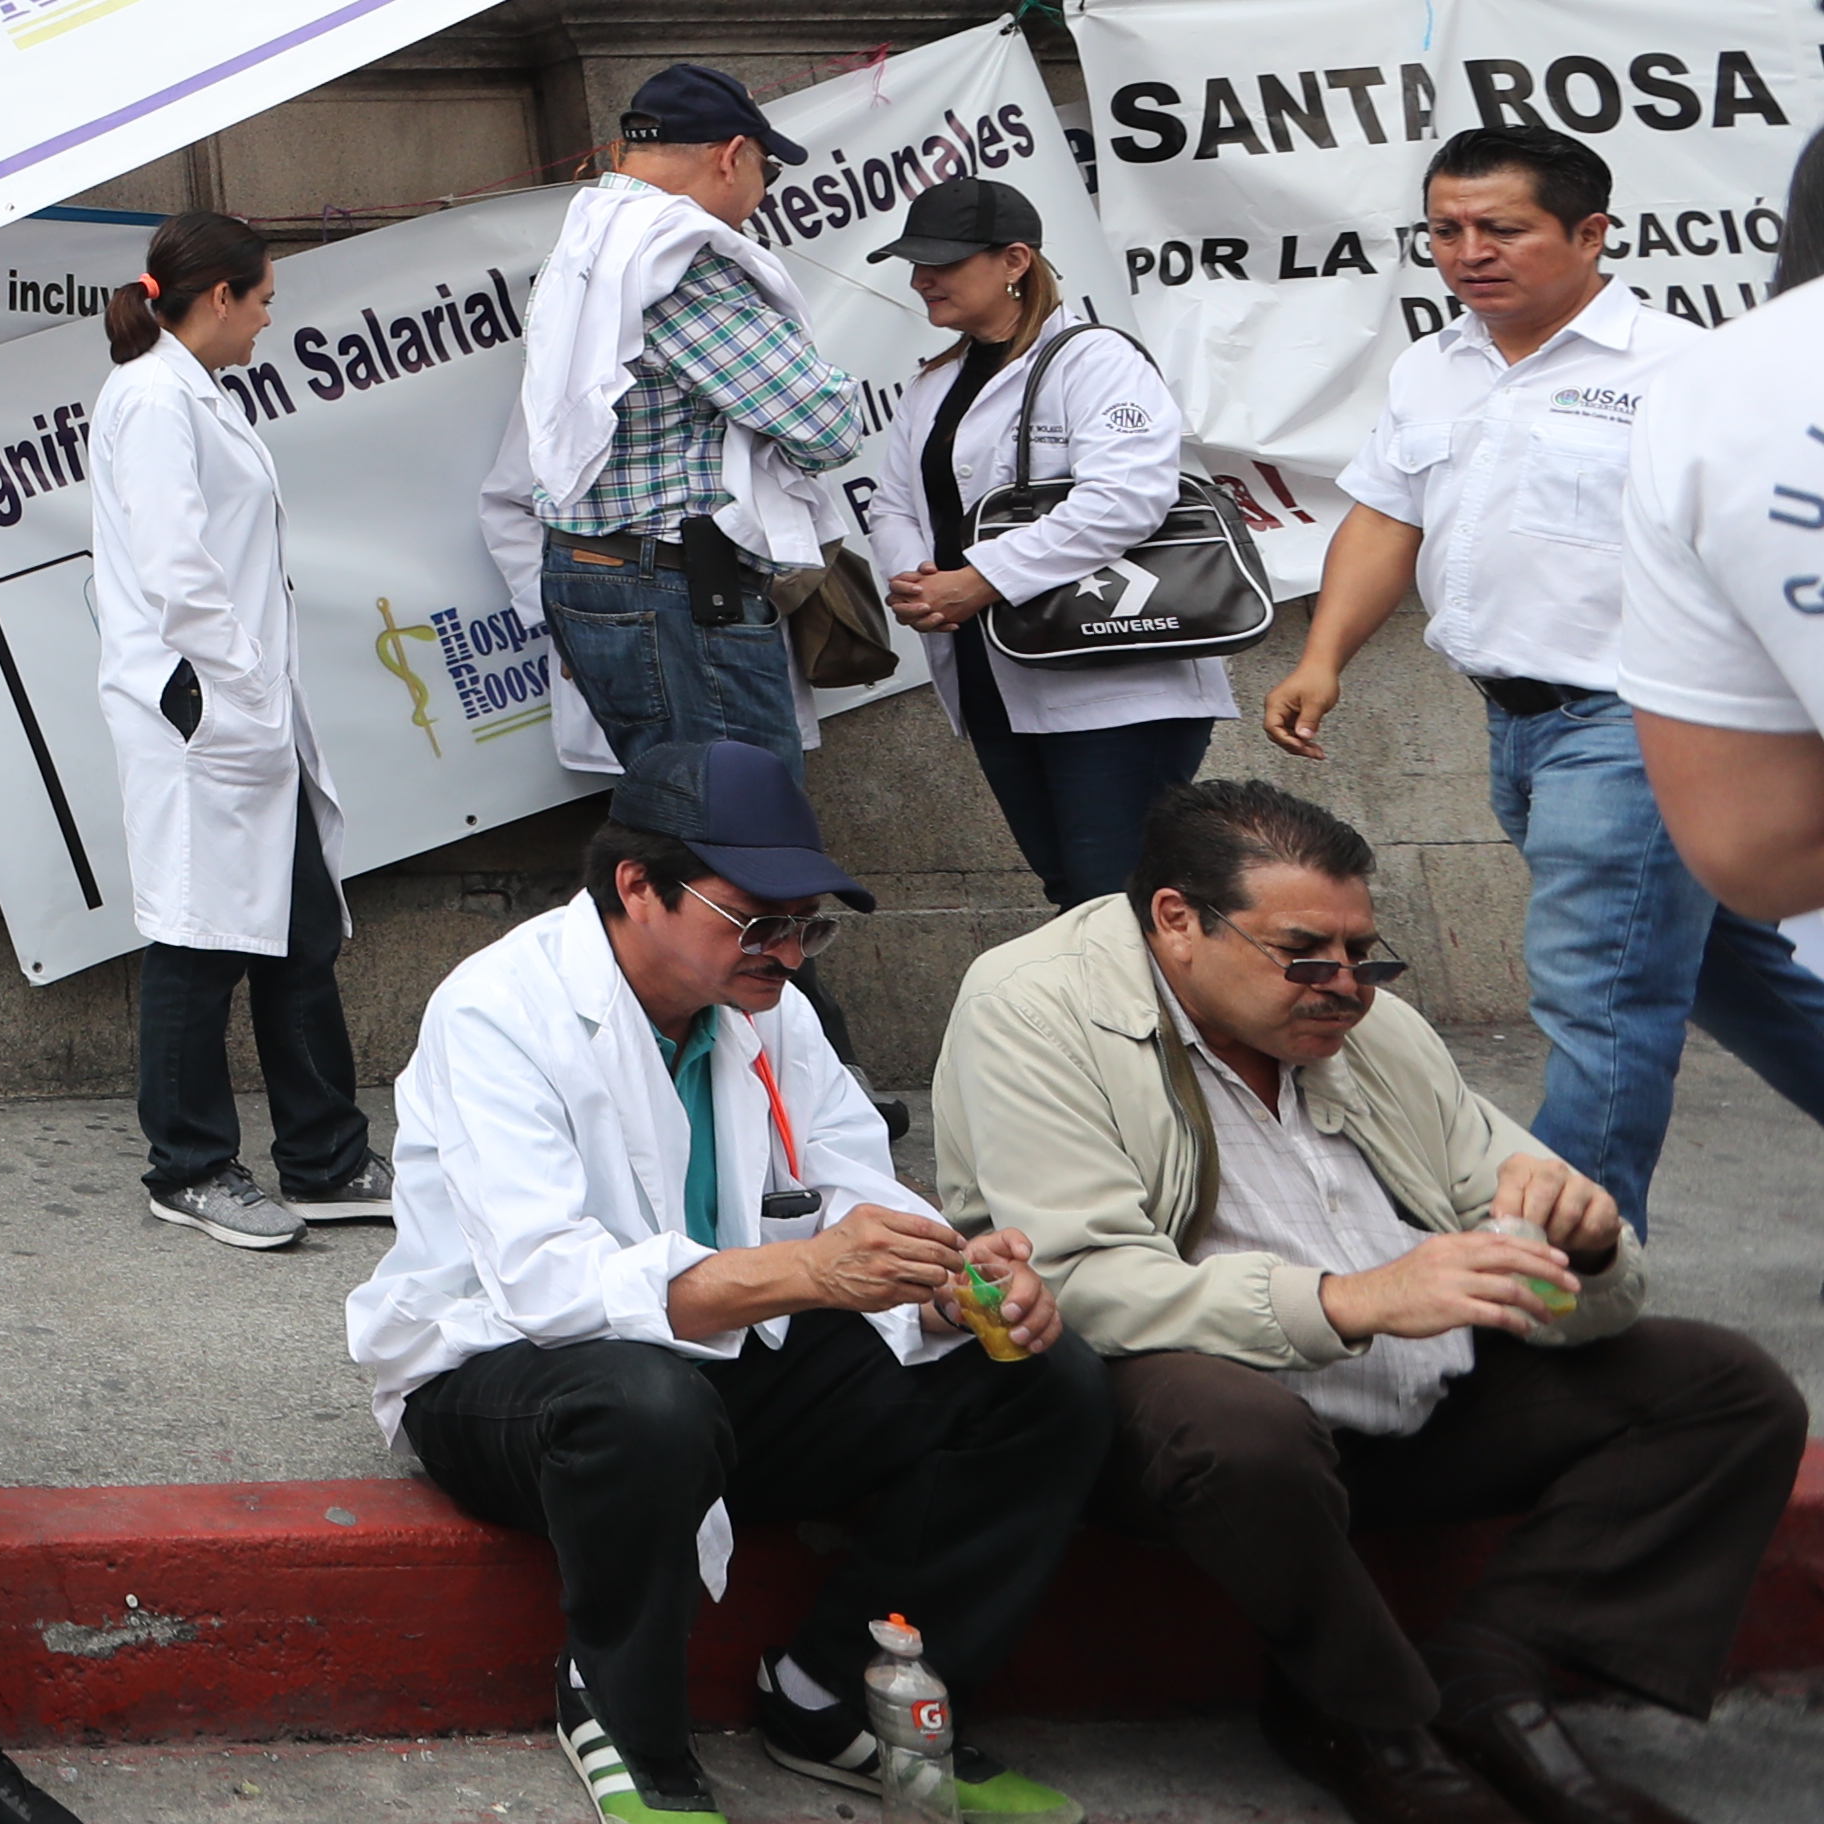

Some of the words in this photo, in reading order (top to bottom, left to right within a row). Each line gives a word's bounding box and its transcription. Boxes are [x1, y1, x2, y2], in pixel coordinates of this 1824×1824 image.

[1109, 62, 1439, 165] SANTA
[1464, 50, 1790, 136] ROSA
[1126, 236, 1251, 296] POR
[1279, 230, 1378, 280] LA
[293, 267, 524, 402] Salarial
[1114, 409, 1145, 427] HNA
[1081, 616, 1180, 636] CONVERSE
